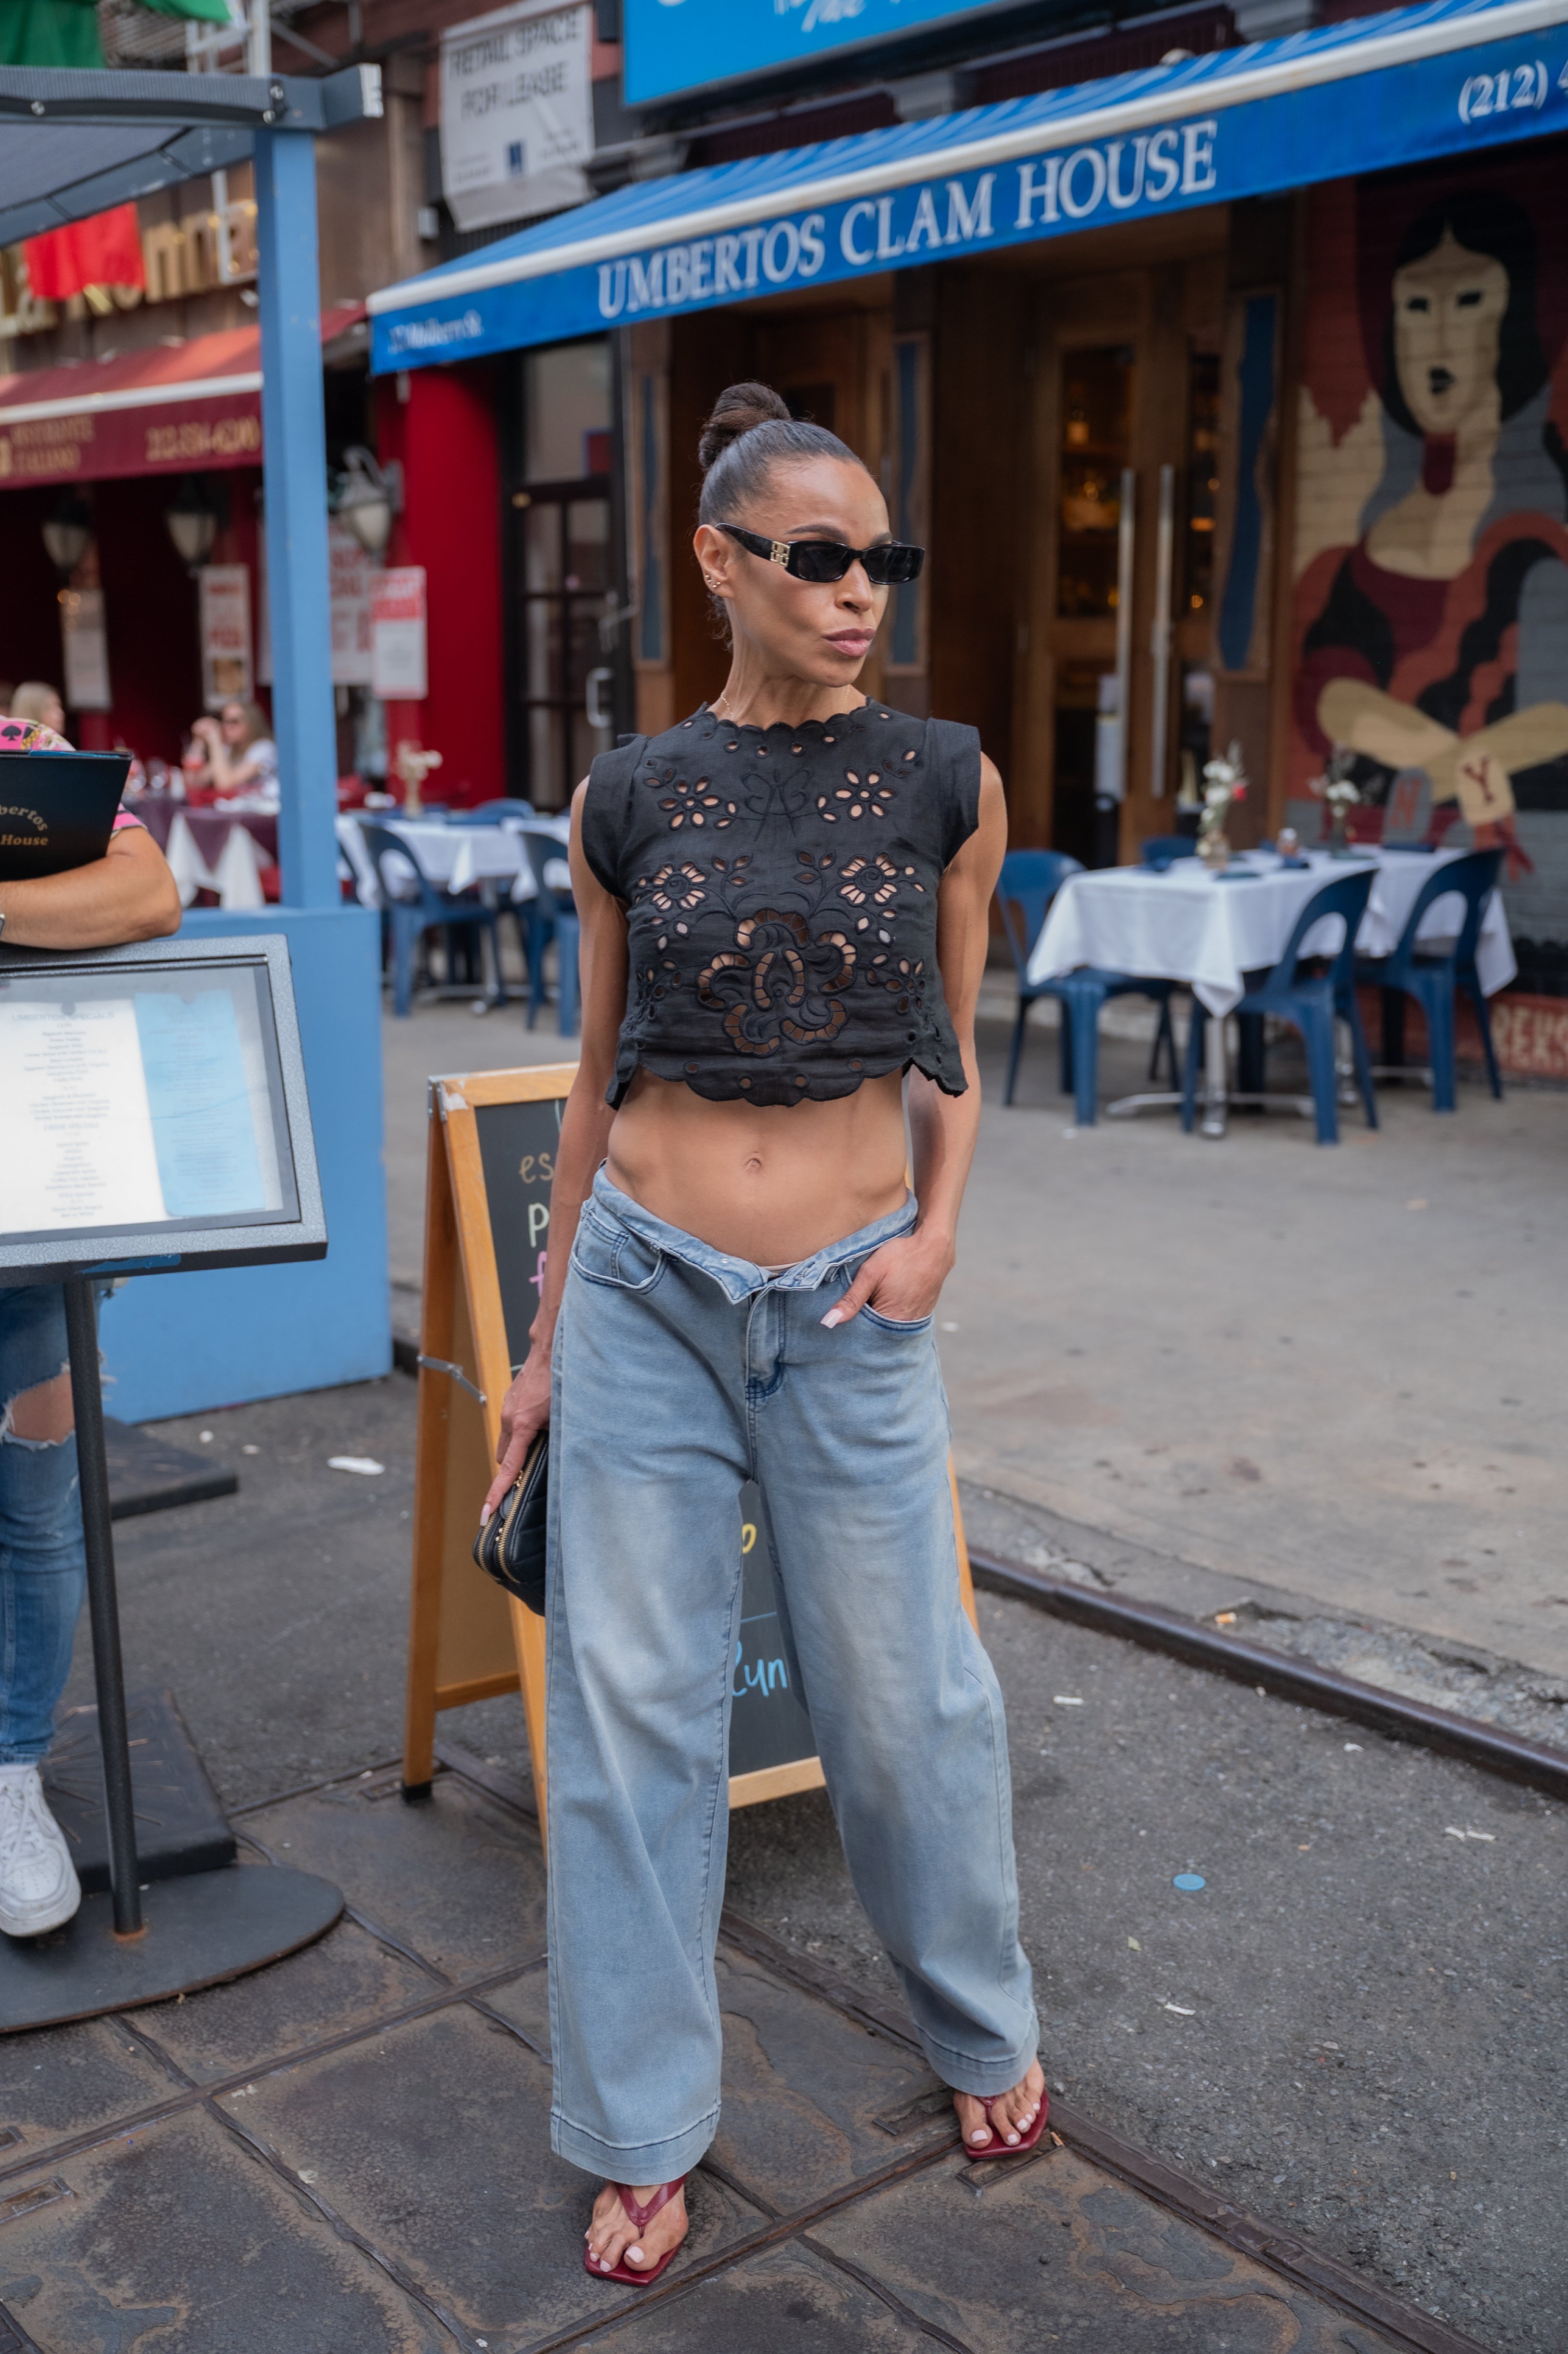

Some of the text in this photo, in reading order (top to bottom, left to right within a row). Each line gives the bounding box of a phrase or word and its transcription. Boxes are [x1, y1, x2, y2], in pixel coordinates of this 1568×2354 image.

[1458, 59, 1548, 125] (212)
[598, 120, 1218, 318] UMBERTOS CLAM HOUSE
[1464, 755, 1494, 803] Y
[0, 804, 48, 831] bertos
[0, 834, 49, 845] House
